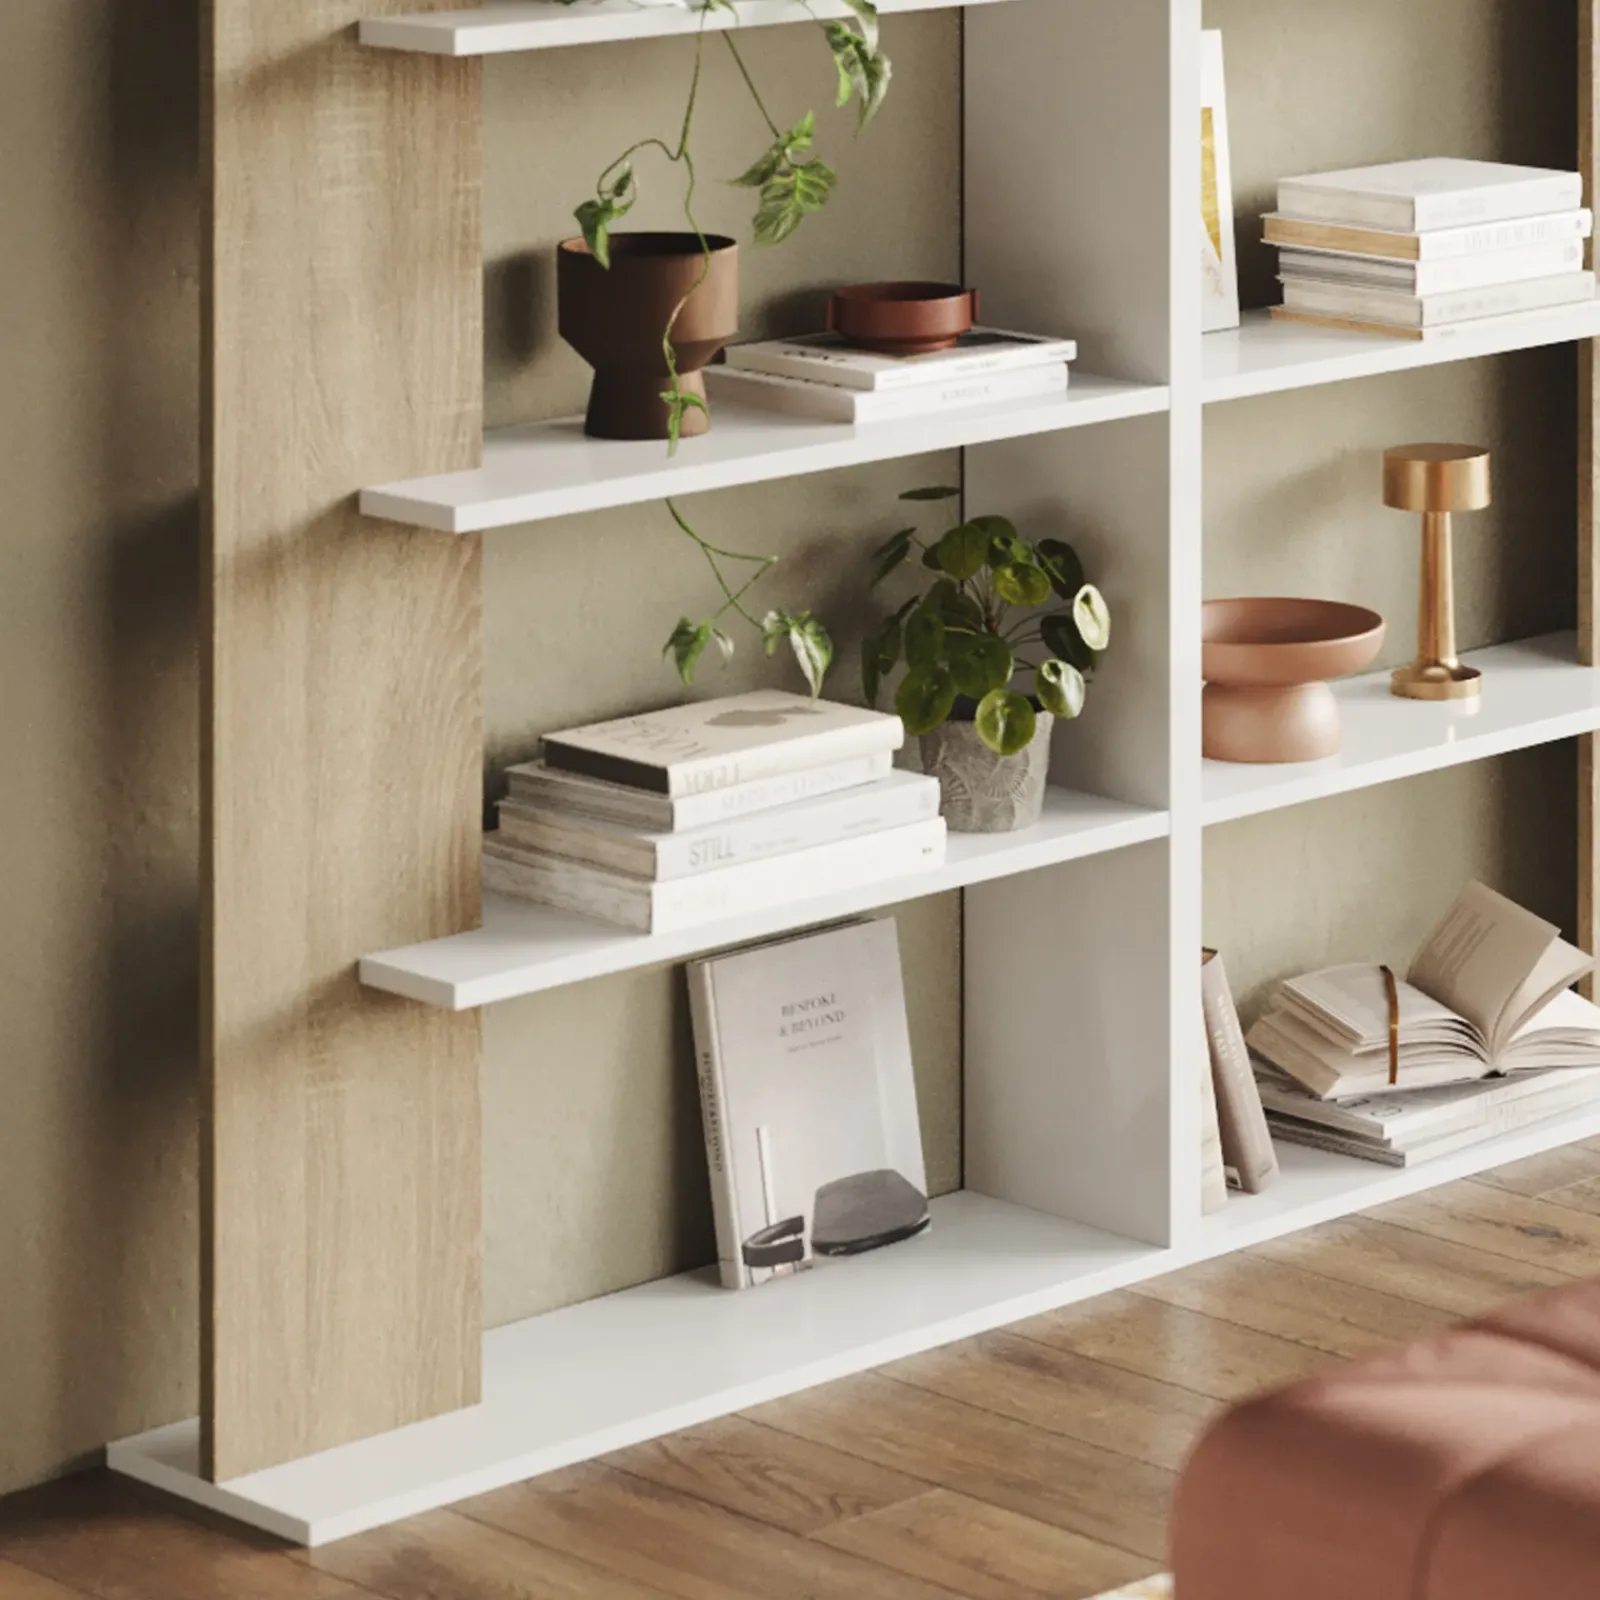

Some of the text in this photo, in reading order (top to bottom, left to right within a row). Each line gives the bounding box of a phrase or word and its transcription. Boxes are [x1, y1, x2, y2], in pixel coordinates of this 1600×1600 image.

[689, 835, 735, 867] STILL
[782, 993, 836, 1017] BESPOKE
[792, 1010, 846, 1034] BEYOND
